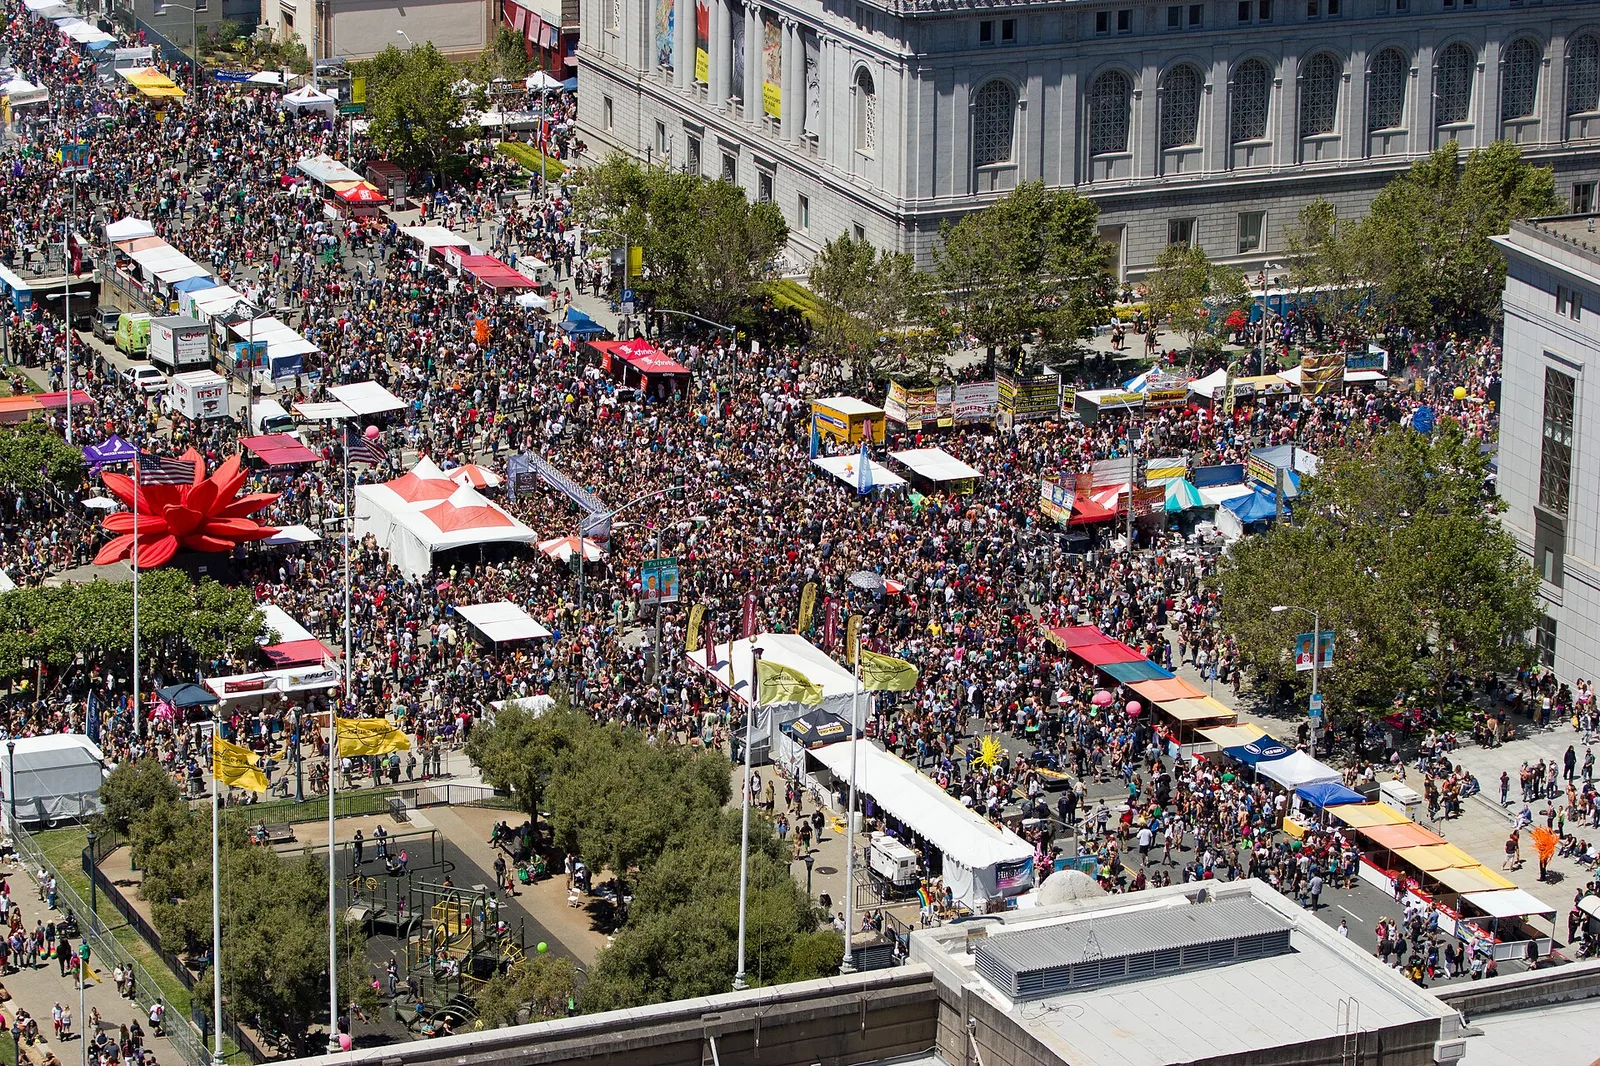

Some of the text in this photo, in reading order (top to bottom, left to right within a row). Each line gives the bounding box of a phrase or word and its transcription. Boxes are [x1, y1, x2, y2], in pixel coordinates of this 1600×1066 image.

[185, 331, 205, 340] Ryder
[955, 405, 986, 414] Sausage
[304, 670, 333, 680] PFLAG
